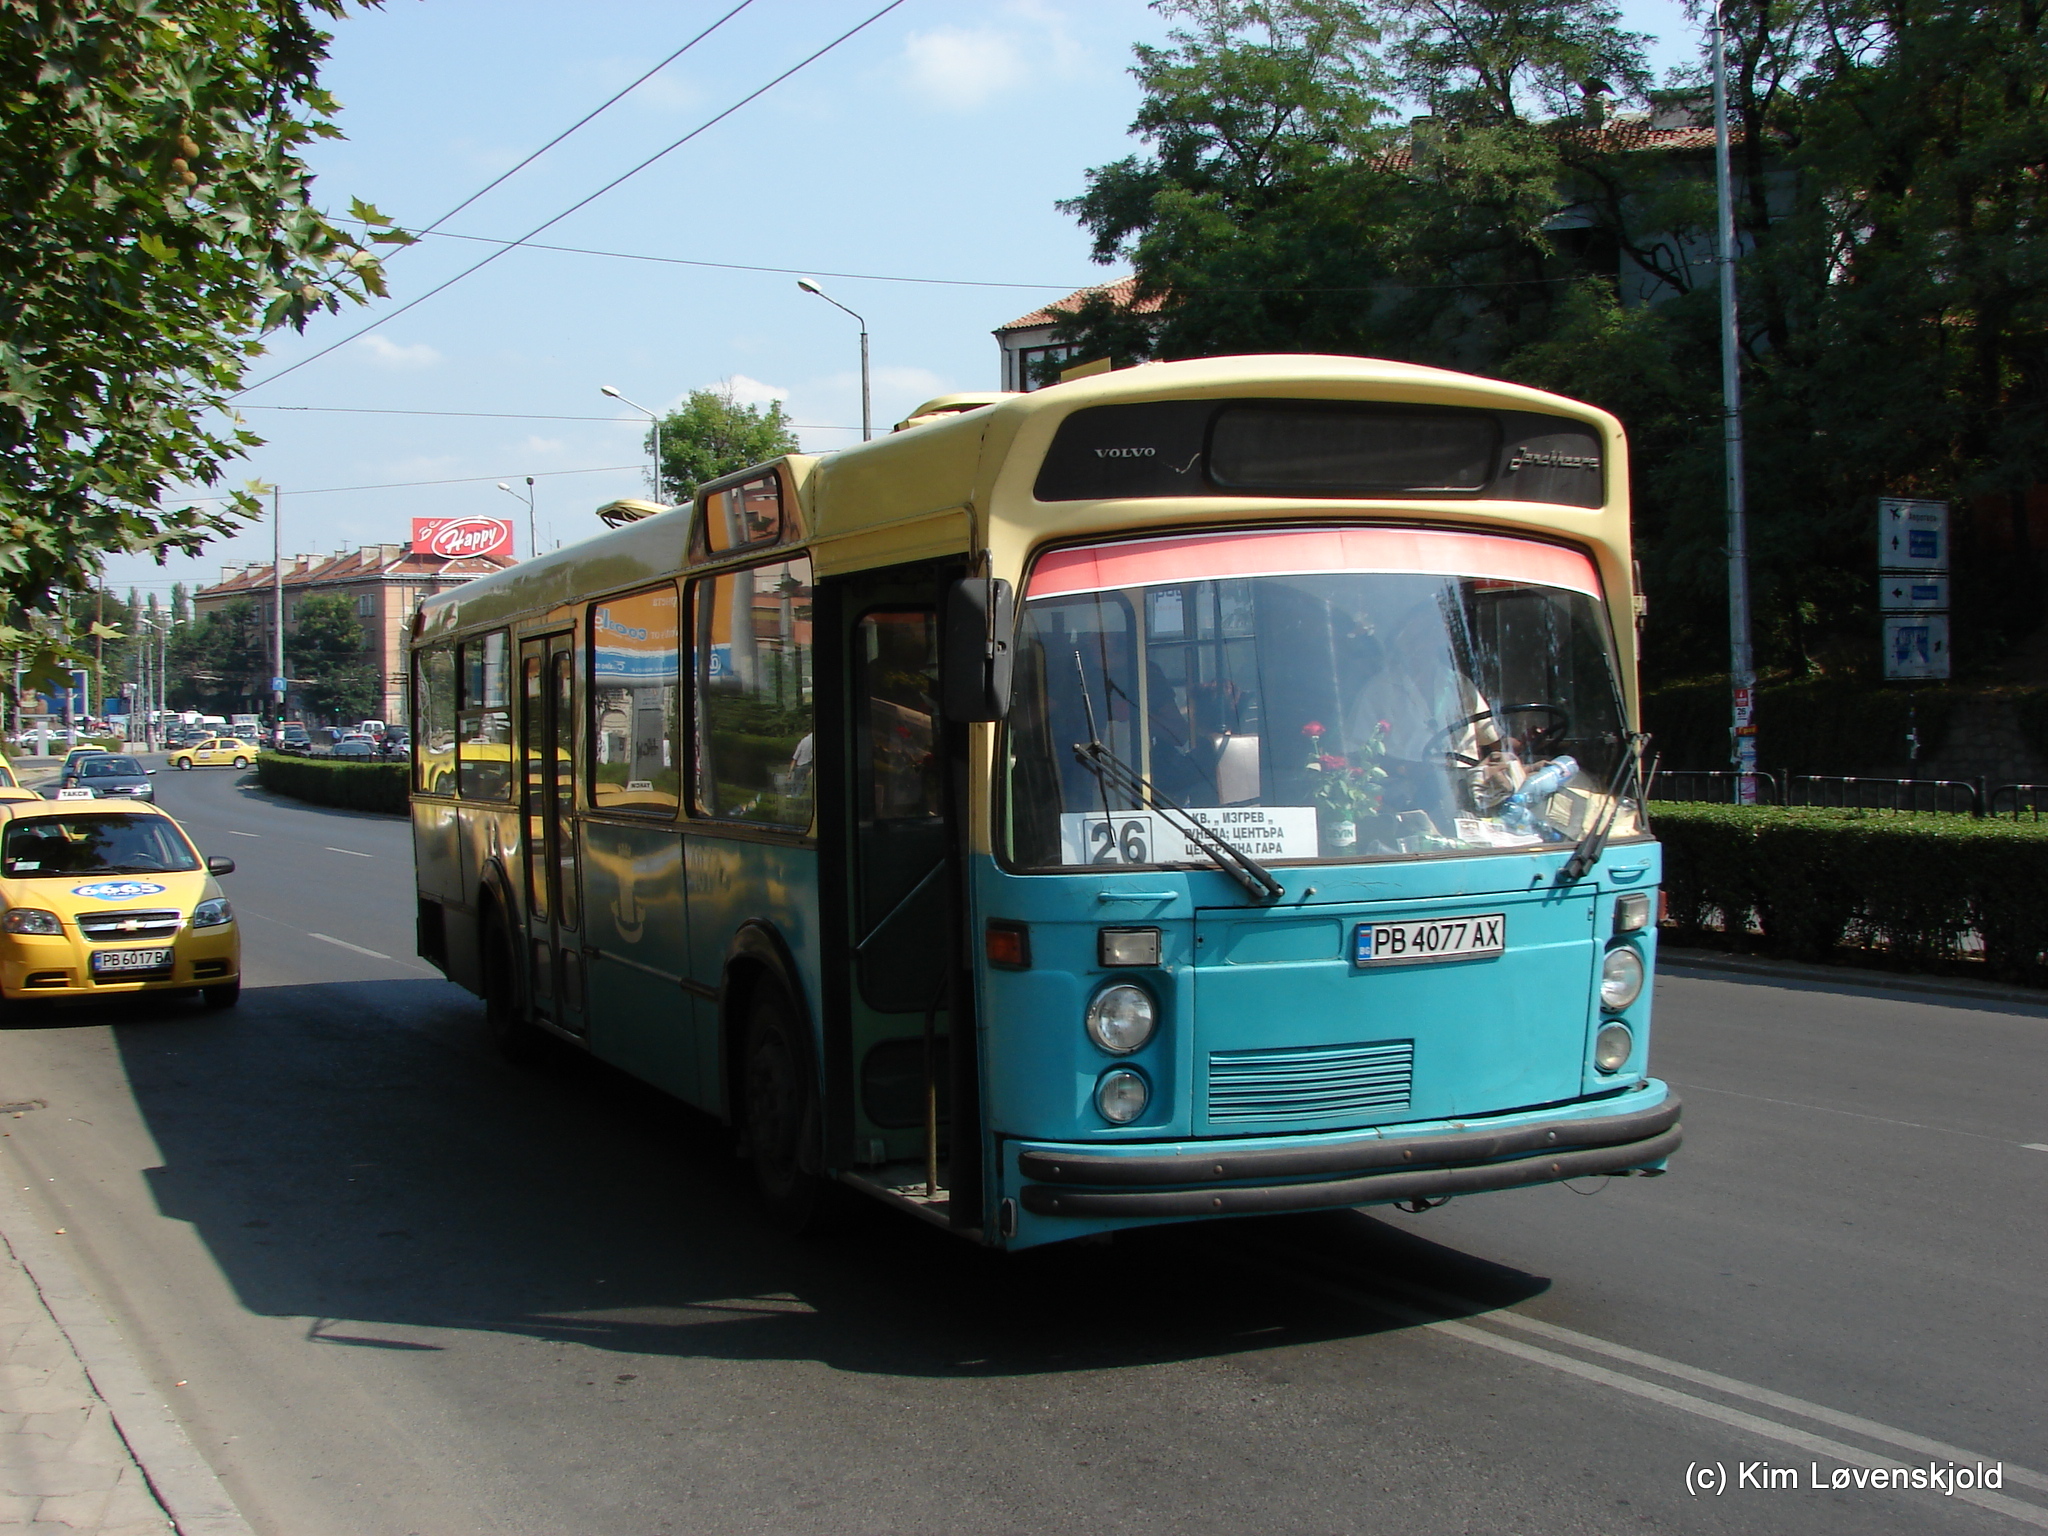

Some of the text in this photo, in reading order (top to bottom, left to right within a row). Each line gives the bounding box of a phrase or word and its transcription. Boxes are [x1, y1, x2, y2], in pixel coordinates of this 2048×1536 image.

[1094, 447, 1156, 458] VOLVO
[439, 526, 498, 555] Happy
[1222, 811, 1265, 823] ИЗГРЕВ
[1232, 826, 1285, 841] ЦЕНТЪРА
[1091, 820, 1147, 864] 26
[1255, 842, 1284, 854] ГАРА
[78, 882, 160, 897] 6665
[1375, 920, 1500, 955] PB 4077 AX
[122, 952, 153, 966] 6017
